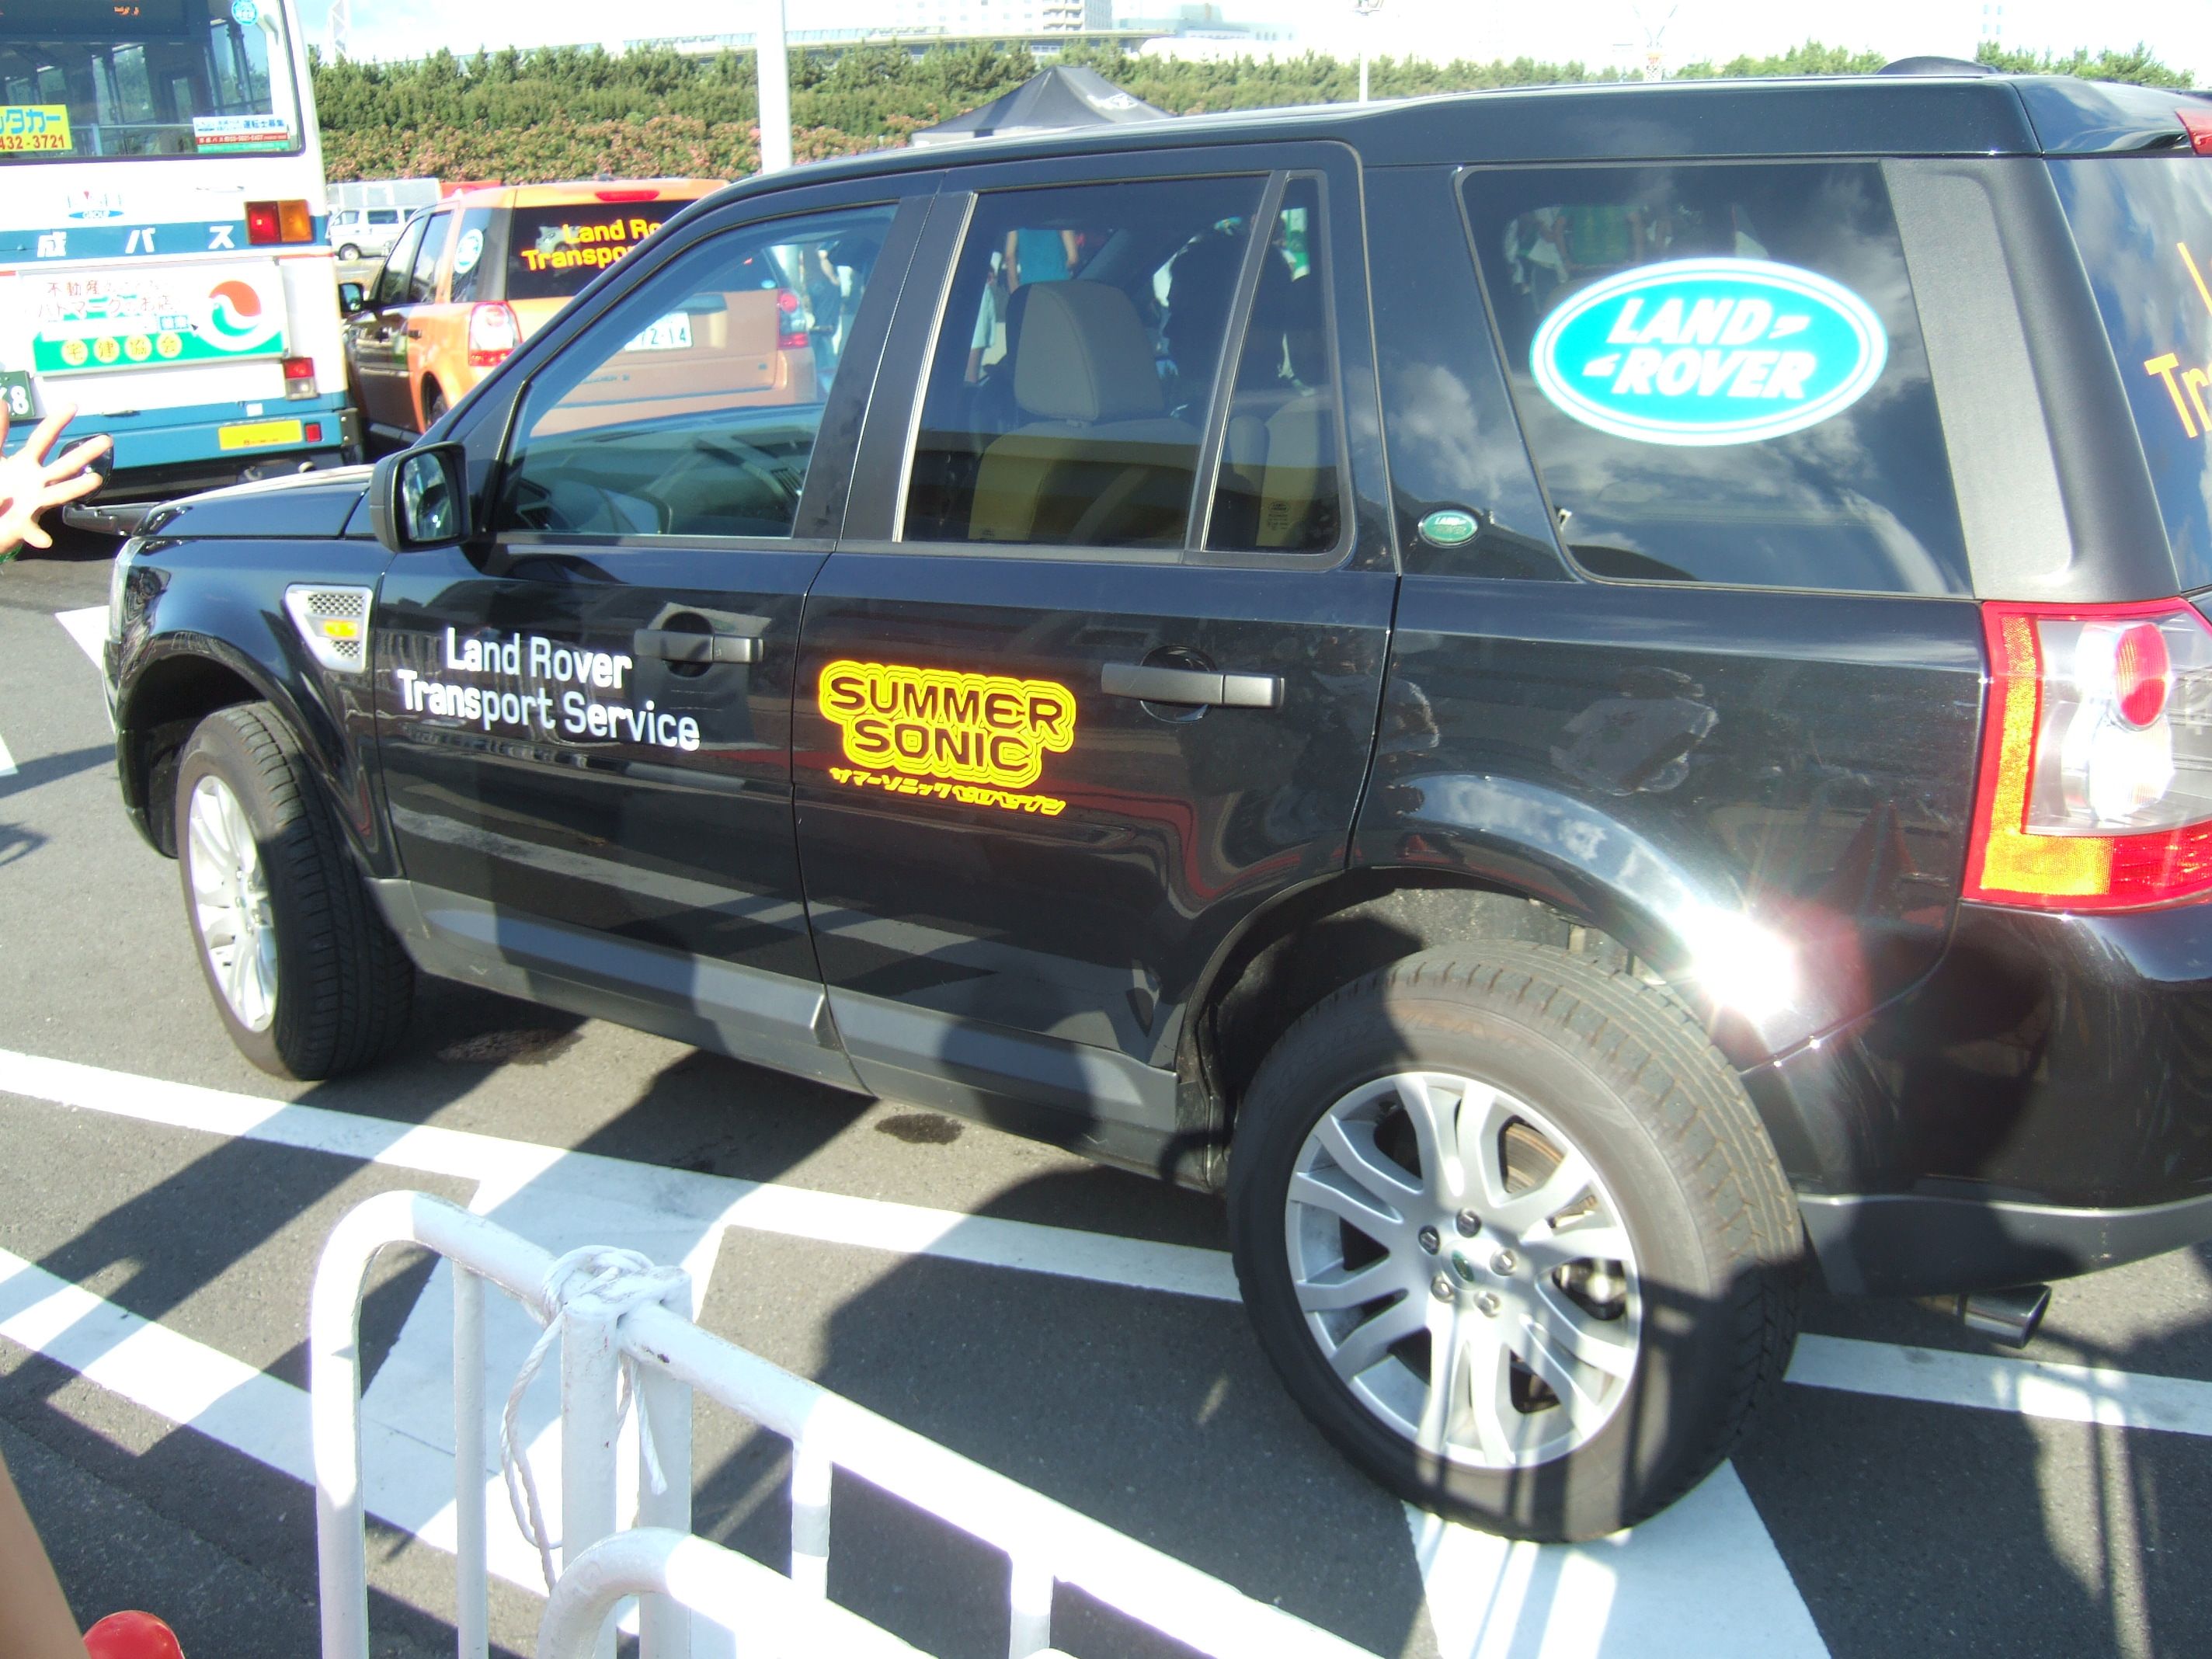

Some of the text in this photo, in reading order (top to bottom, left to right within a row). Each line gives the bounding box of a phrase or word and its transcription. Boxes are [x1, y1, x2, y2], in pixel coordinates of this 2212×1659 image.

[0, 108, 61, 134] タカー
[562, 218, 626, 245] Land
[1606, 297, 1774, 345] LAND
[1611, 348, 1817, 398] ROVER
[2144, 353, 2212, 439] Tr
[446, 627, 633, 690] Land Rover
[396, 669, 701, 752] Transport Service
[828, 673, 1065, 739] SUMMER
[852, 717, 1035, 773] SONIC
